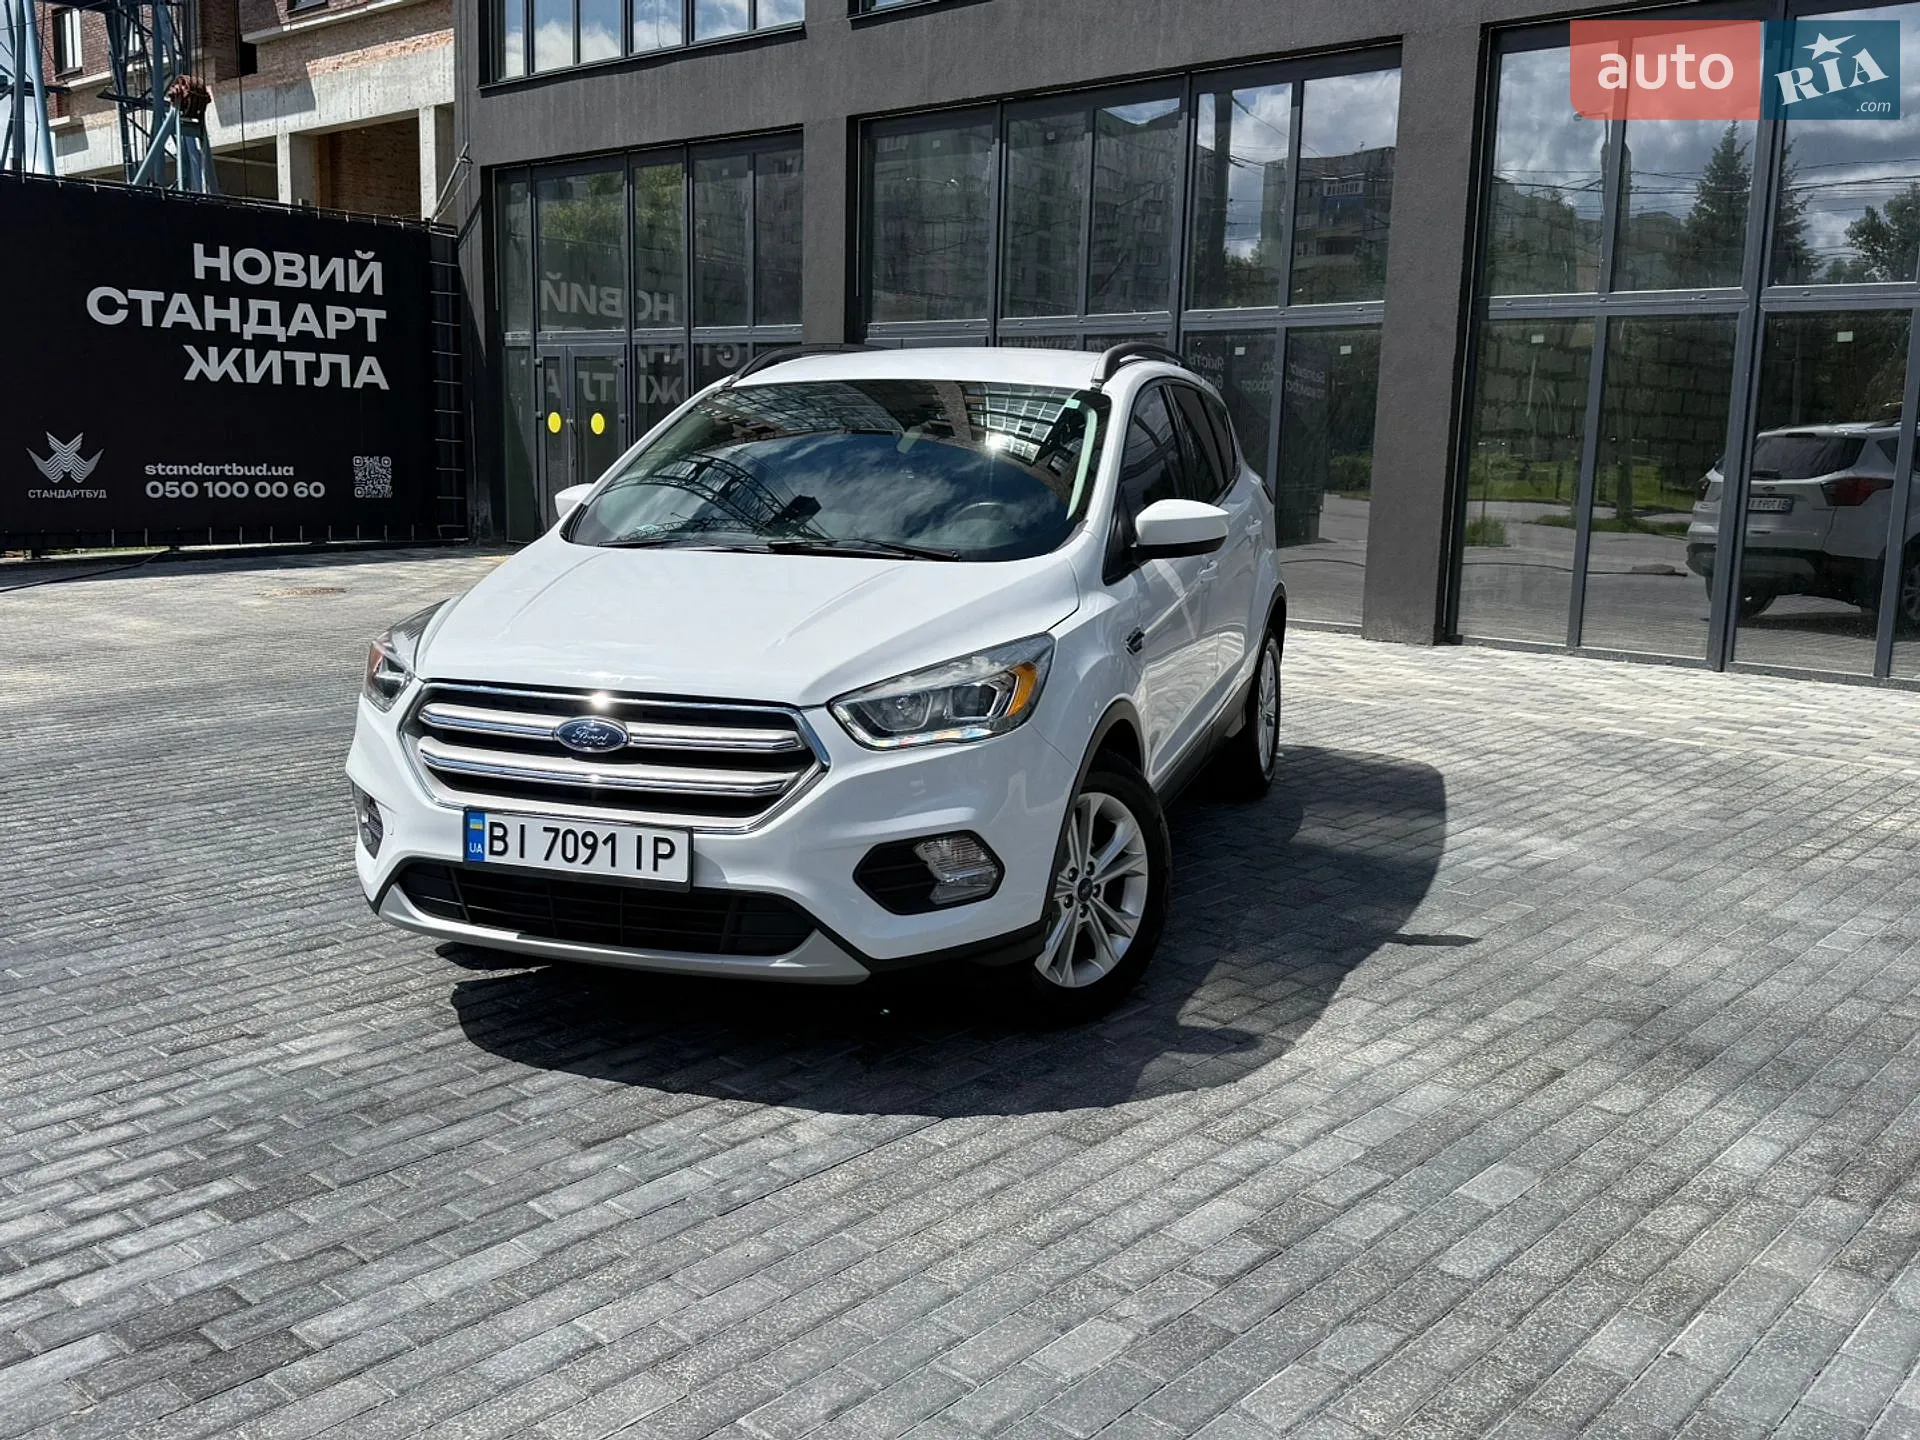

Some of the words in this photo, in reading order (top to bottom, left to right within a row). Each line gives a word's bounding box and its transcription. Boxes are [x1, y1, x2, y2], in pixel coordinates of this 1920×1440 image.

[193, 242, 383, 296] НОВИЙ
[86, 286, 387, 342] СТАНДАРТ
[183, 344, 390, 391] ЖИТЛА
[145, 462, 294, 476] standartbud.ua
[28, 488, 107, 499] СТАНДАРТБУД
[145, 481, 199, 499] 050
[203, 481, 249, 499] 100
[254, 481, 289, 499] 00
[293, 481, 326, 499] 60
[571, 726, 610, 746] Ford
[469, 842, 483, 854] UA
[488, 821, 525, 858] BI
[542, 826, 617, 868] 7091
[635, 834, 676, 872] IP
